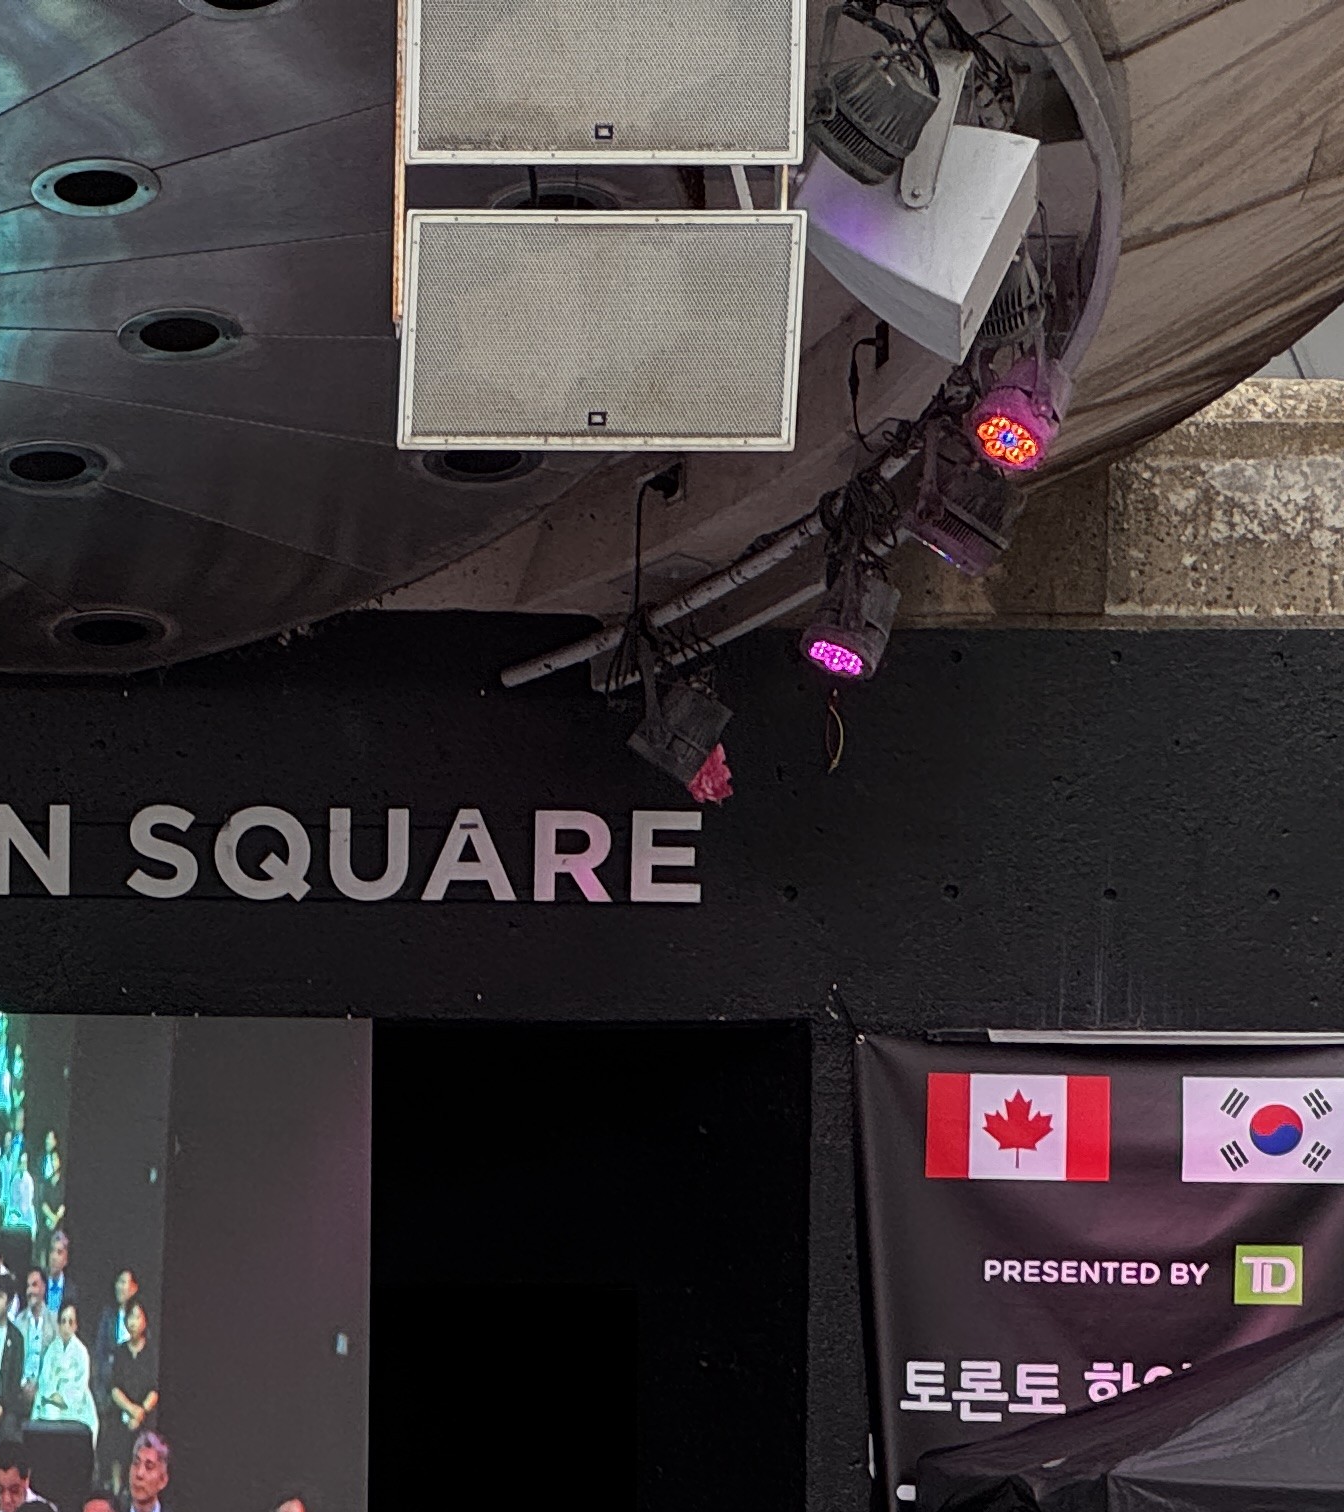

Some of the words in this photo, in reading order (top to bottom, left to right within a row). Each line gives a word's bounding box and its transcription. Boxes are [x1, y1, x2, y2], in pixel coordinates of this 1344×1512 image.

[126, 804, 703, 905] SQUARE
[983, 1259, 1161, 1285] PRESENTED
[1170, 1263, 1210, 1287] BY
[1242, 1256, 1296, 1295] TD
[900, 1360, 1067, 1422] 토론토
